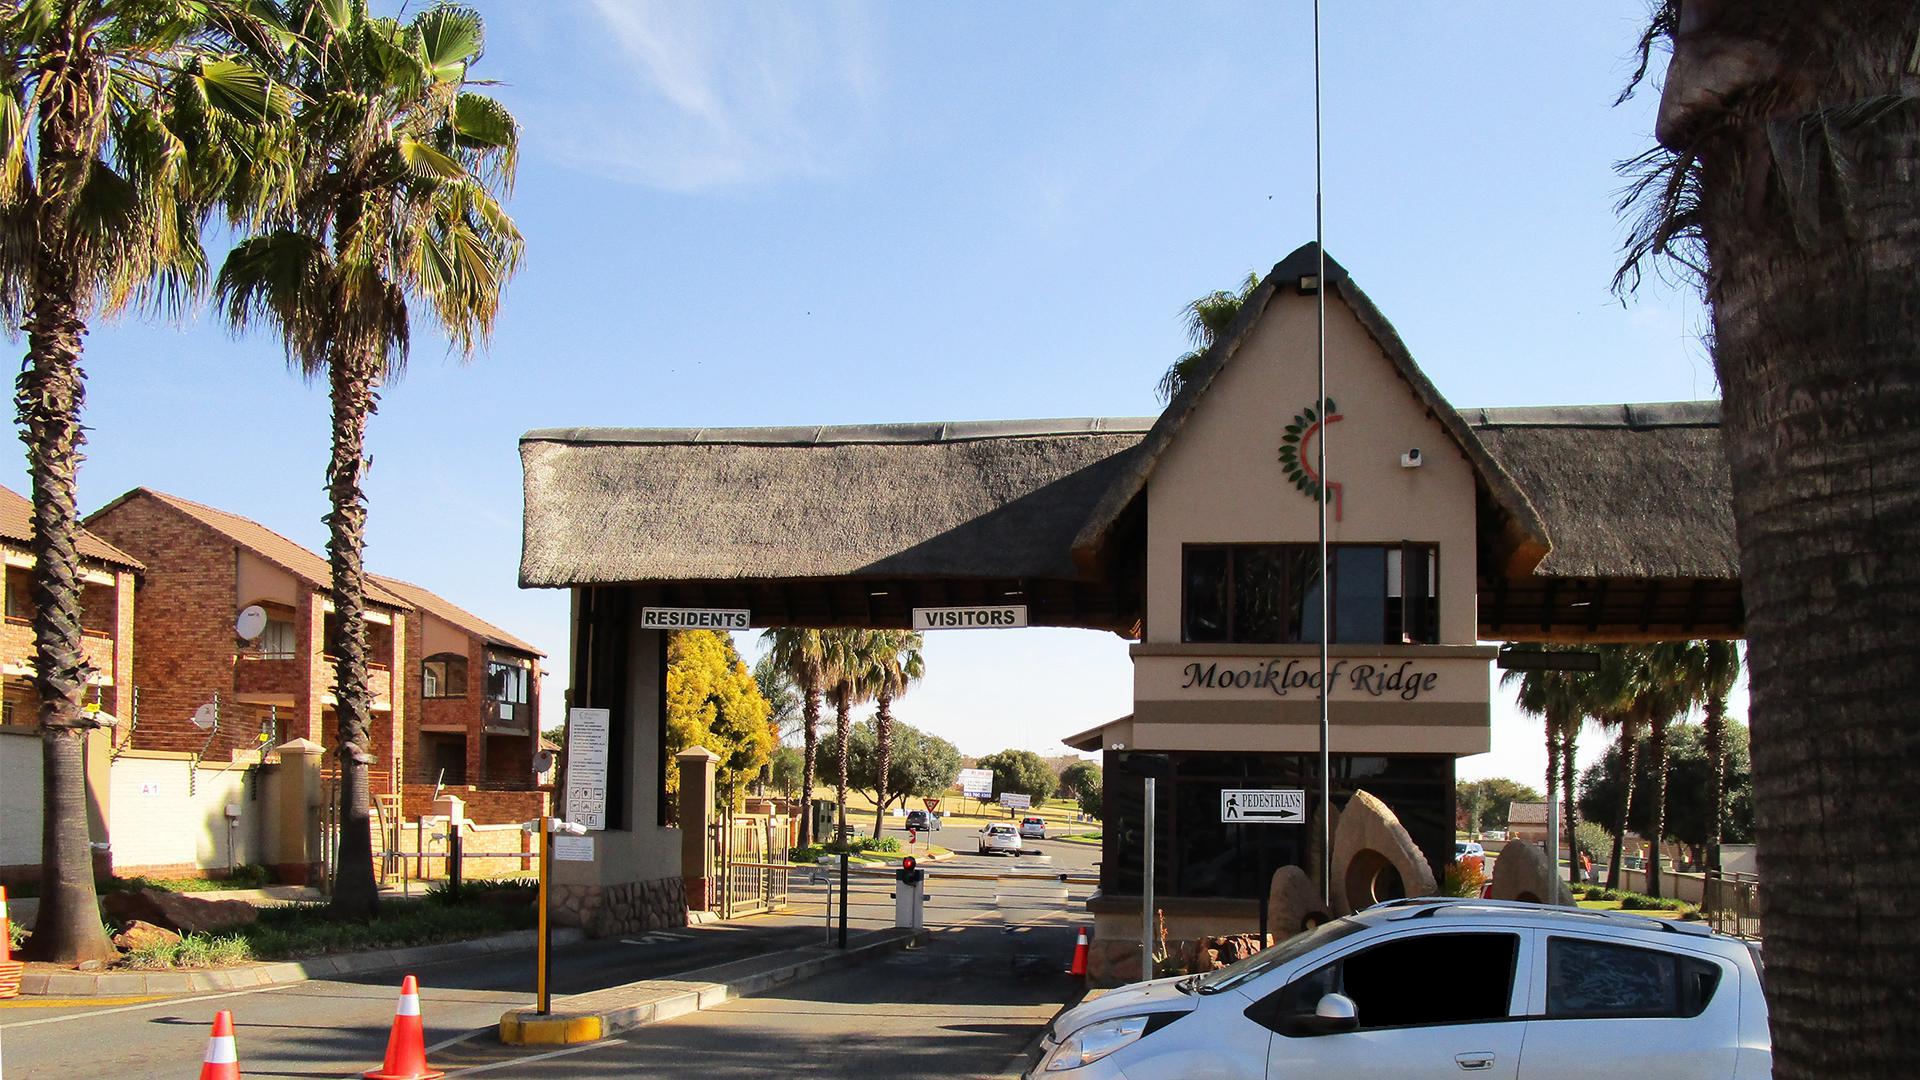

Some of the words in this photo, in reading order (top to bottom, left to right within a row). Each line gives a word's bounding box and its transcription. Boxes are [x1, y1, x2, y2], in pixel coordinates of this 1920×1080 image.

[645, 611, 747, 627] RESIDENTS
[925, 610, 1015, 626] VISITORS
[1181, 659, 1347, 699] Mooikloof
[1350, 660, 1438, 700] Ridge
[1242, 793, 1301, 808] PEDESTRIANS
